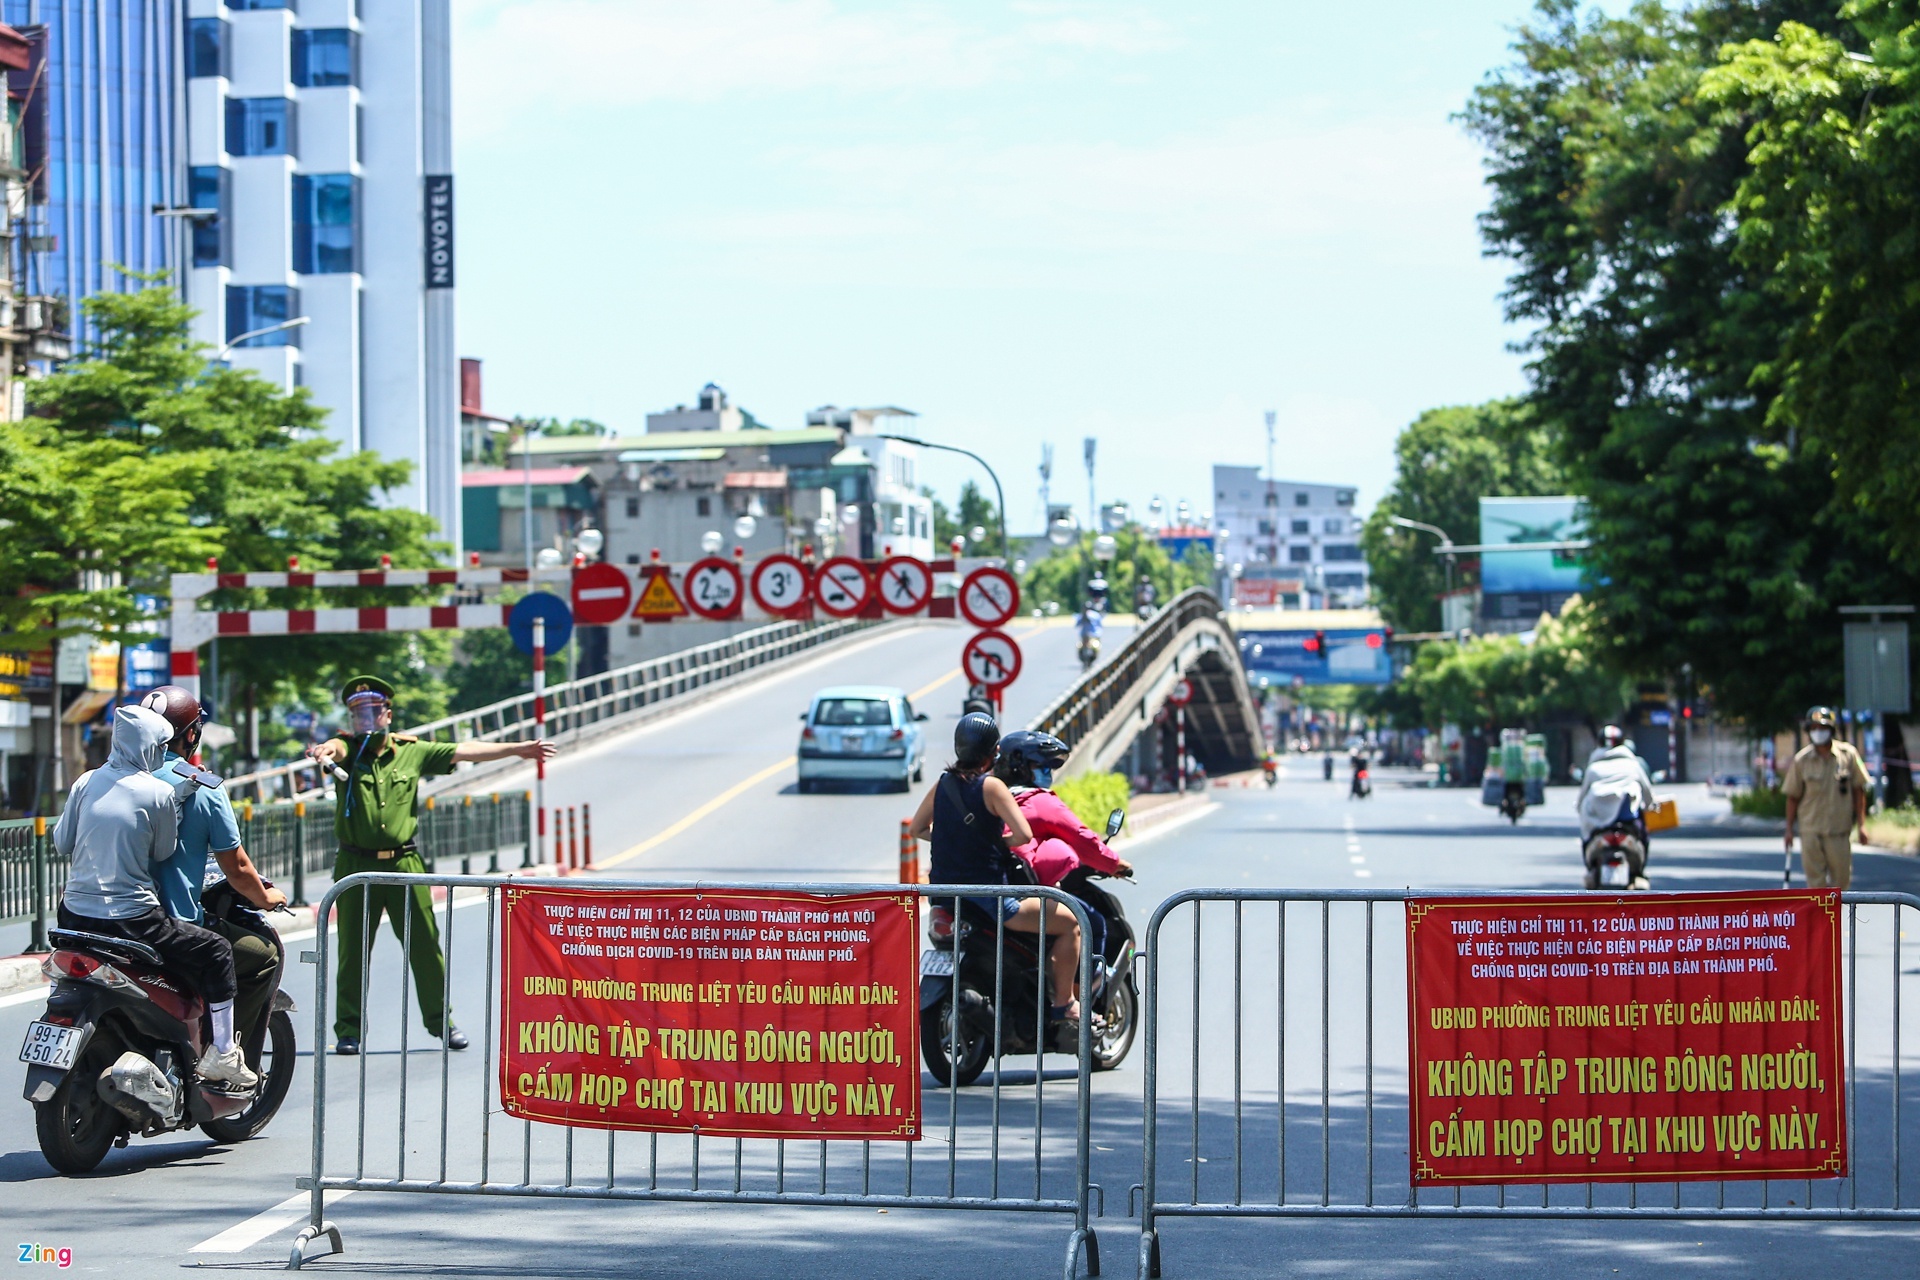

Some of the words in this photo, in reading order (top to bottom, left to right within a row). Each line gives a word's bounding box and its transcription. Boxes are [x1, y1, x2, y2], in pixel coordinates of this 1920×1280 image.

[431, 181, 449, 283] NOVOTEL
[543, 904, 575, 923] THỰC
[577, 904, 607, 922] HIỆN
[609, 903, 632, 920] CHỈ
[633, 907, 653, 923] THỊ
[656, 908, 675, 922] 11,
[678, 908, 693, 921] 12
[696, 903, 721, 921] CỦA
[724, 909, 758, 922] UBND
[760, 906, 802, 924] THÀNH
[804, 909, 831, 924] PHỐ
[832, 909, 850, 924] HÀ
[853, 908, 876, 926] NỘI
[1450, 919, 1484, 940] THỰC
[1487, 917, 1517, 937] HIỆN
[1520, 914, 1542, 934] CHỈ
[1545, 918, 1565, 936] THỊ
[1569, 918, 1589, 935] 11,
[1591, 918, 1607, 933] 12
[1610, 913, 1637, 932] CỦA
[1639, 916, 1675, 932] UBND
[1677, 913, 1720, 931] THÀNH
[1723, 910, 1749, 929] PHỐ
[1752, 910, 1770, 928] HÀ
[1773, 909, 1797, 930] NỘI
[548, 920, 564, 937] VỀ
[566, 922, 593, 943] VIỆC
[595, 925, 628, 941] THỰC
[630, 924, 660, 942] HIỆN
[663, 924, 688, 940] CÁC
[690, 925, 720, 943] BIỆN
[723, 926, 757, 941] PHÁP
[760, 925, 784, 942] CẤP
[787, 927, 821, 943] BÁCH
[823, 927, 872, 947] PHÒNG,
[1456, 937, 1473, 956] VỀ
[1475, 939, 1504, 960] VIỆC
[1507, 940, 1540, 959] THỰC
[1543, 938, 1573, 958] HIỆN
[1577, 937, 1603, 955] CÁC
[1606, 937, 1636, 958] BIỆN
[1639, 936, 1674, 954] PHÁP
[1677, 933, 1703, 953] CẤP
[1706, 934, 1740, 952] BÁCH
[1743, 932, 1791, 951] PHÒNG,
[561, 939, 603, 957] CHỐNG
[605, 945, 635, 960] DỊCH
[637, 945, 694, 960] COVID-19
[696, 944, 729, 960] TRÊN
[731, 947, 753, 963] ĐỊA
[755, 945, 782, 961] BÀN
[784, 946, 825, 962] THÀNH
[828, 944, 858, 962] PHỐ.
[1471, 959, 1515, 979] CHỐNG
[1517, 963, 1548, 981] DỊCH
[1551, 962, 1609, 978] COVID-19
[1611, 959, 1645, 976] TRÊN
[1647, 961, 1670, 978] ĐỊA
[1673, 957, 1700, 975] BÀN
[1702, 956, 1745, 974] THÀNH
[1748, 952, 1778, 972] PHỐ.
[523, 976, 567, 997] UBND
[572, 976, 636, 1001] PHƯỜNG
[640, 982, 694, 1003] TRUNG
[698, 979, 732, 1008] LIỆT
[735, 980, 767, 1004] YÊU
[771, 978, 804, 1005] CẦU
[808, 981, 855, 1005] NHÂN
[859, 981, 899, 1005] DÂN:
[1431, 1007, 1477, 1030] UBND
[1482, 1000, 1551, 1029] PHƯỜNG
[1554, 1004, 1610, 1027] TRUNG
[1615, 999, 1649, 1030] LIỆT
[1653, 998, 1685, 1026] YÊU
[1690, 994, 1723, 1025] CẦU
[1728, 996, 1776, 1024] NHÂN
[1780, 995, 1821, 1022] DÂN:
[34, 1026, 74, 1047] 99-F1
[518, 1014, 600, 1055] KHÔNG
[607, 1018, 651, 1064] TẬP
[657, 1027, 738, 1062] TRUNG
[744, 1023, 811, 1063] ĐÔNG
[819, 1022, 902, 1068] NGƯỜI,
[24, 1043, 71, 1066] 450.24
[1427, 1051, 1513, 1097] KHÔNG
[1520, 1050, 1567, 1102] TẬP
[1574, 1056, 1657, 1094] TRUNG
[1664, 1047, 1733, 1093] ĐÔNG
[1741, 1042, 1826, 1094] NGƯỜI,
[518, 1061, 573, 1104] CẤM
[578, 1074, 628, 1113] HỌP
[635, 1076, 685, 1117] CHỢ
[689, 1080, 727, 1119] TẠI
[734, 1081, 783, 1115] KHU
[790, 1079, 838, 1122] VỰC
[845, 1076, 903, 1117] NÀY.
[1429, 1106, 1486, 1158] CẤM
[1493, 1118, 1543, 1164] HỌP
[1551, 1114, 1603, 1163] CHỢ
[1608, 1116, 1647, 1162] TẠI
[1655, 1115, 1705, 1153] KHU
[1712, 1110, 1761, 1160] VỰC
[1769, 1105, 1827, 1151] NÀY.
